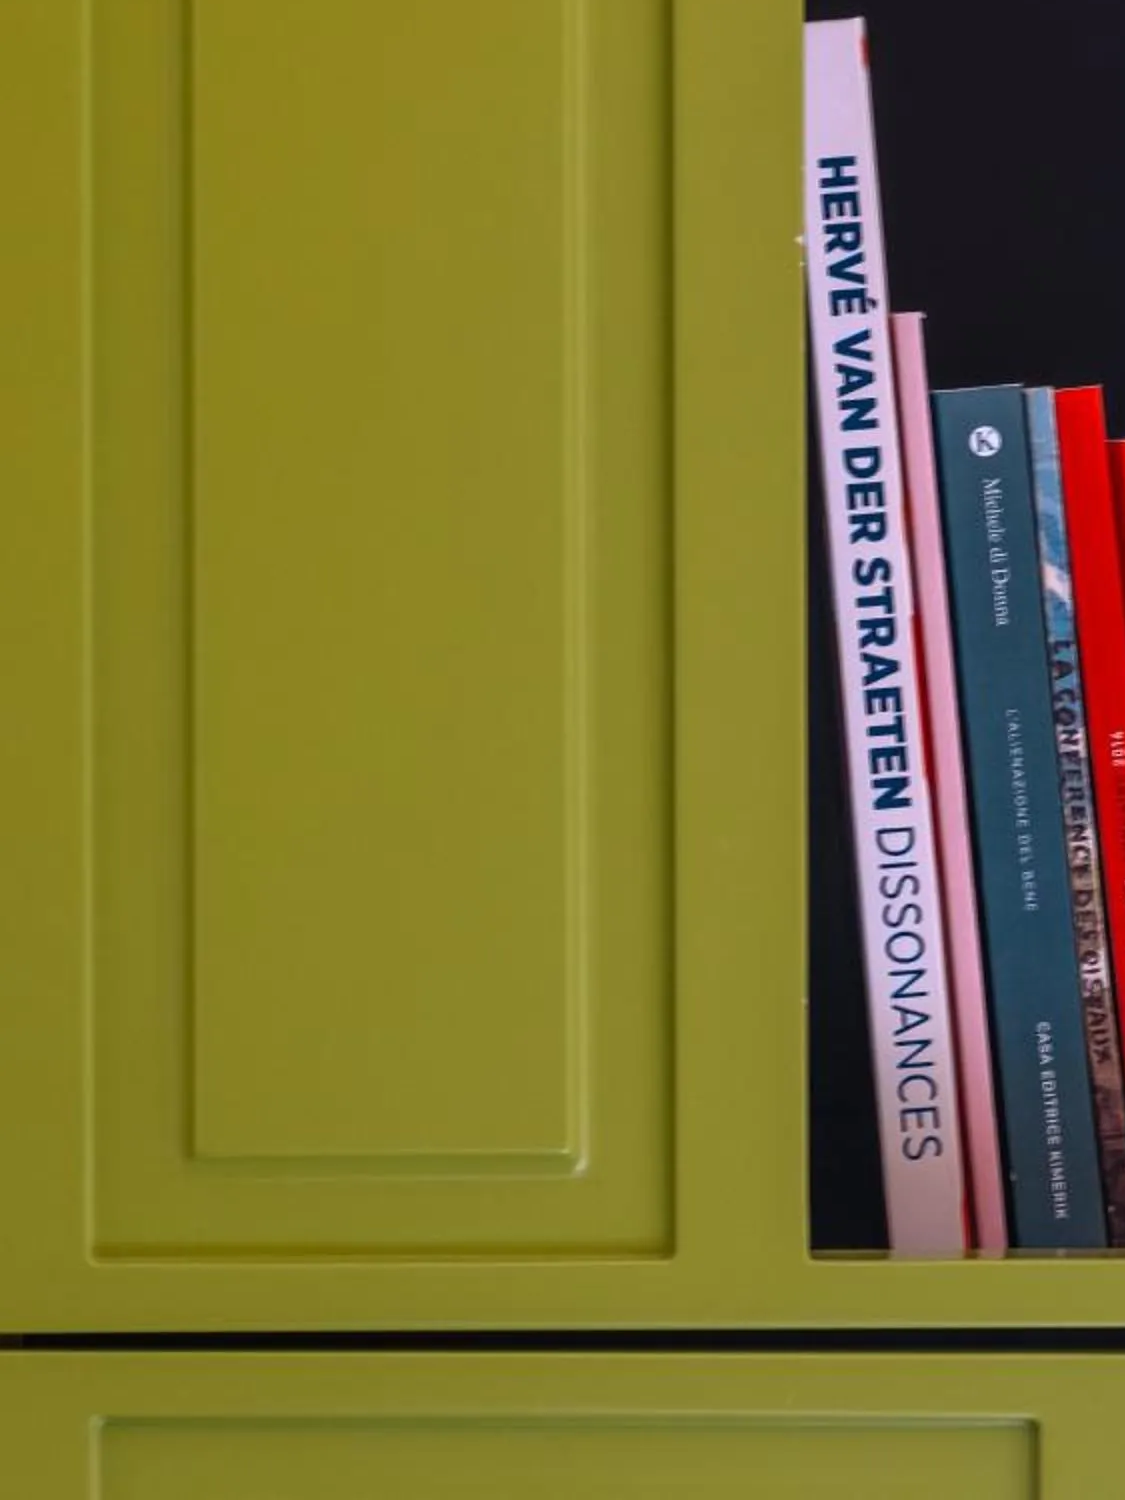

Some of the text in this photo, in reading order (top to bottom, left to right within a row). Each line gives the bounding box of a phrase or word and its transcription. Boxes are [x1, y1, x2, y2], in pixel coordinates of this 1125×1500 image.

[816, 154, 943, 1160] HERVÉ VAN DER STRAETEN DISSONANCES
[1051, 639, 1074, 680] LA
[1035, 1020, 1054, 1064] CASA
[1040, 1069, 1062, 1144] EDITRICE
